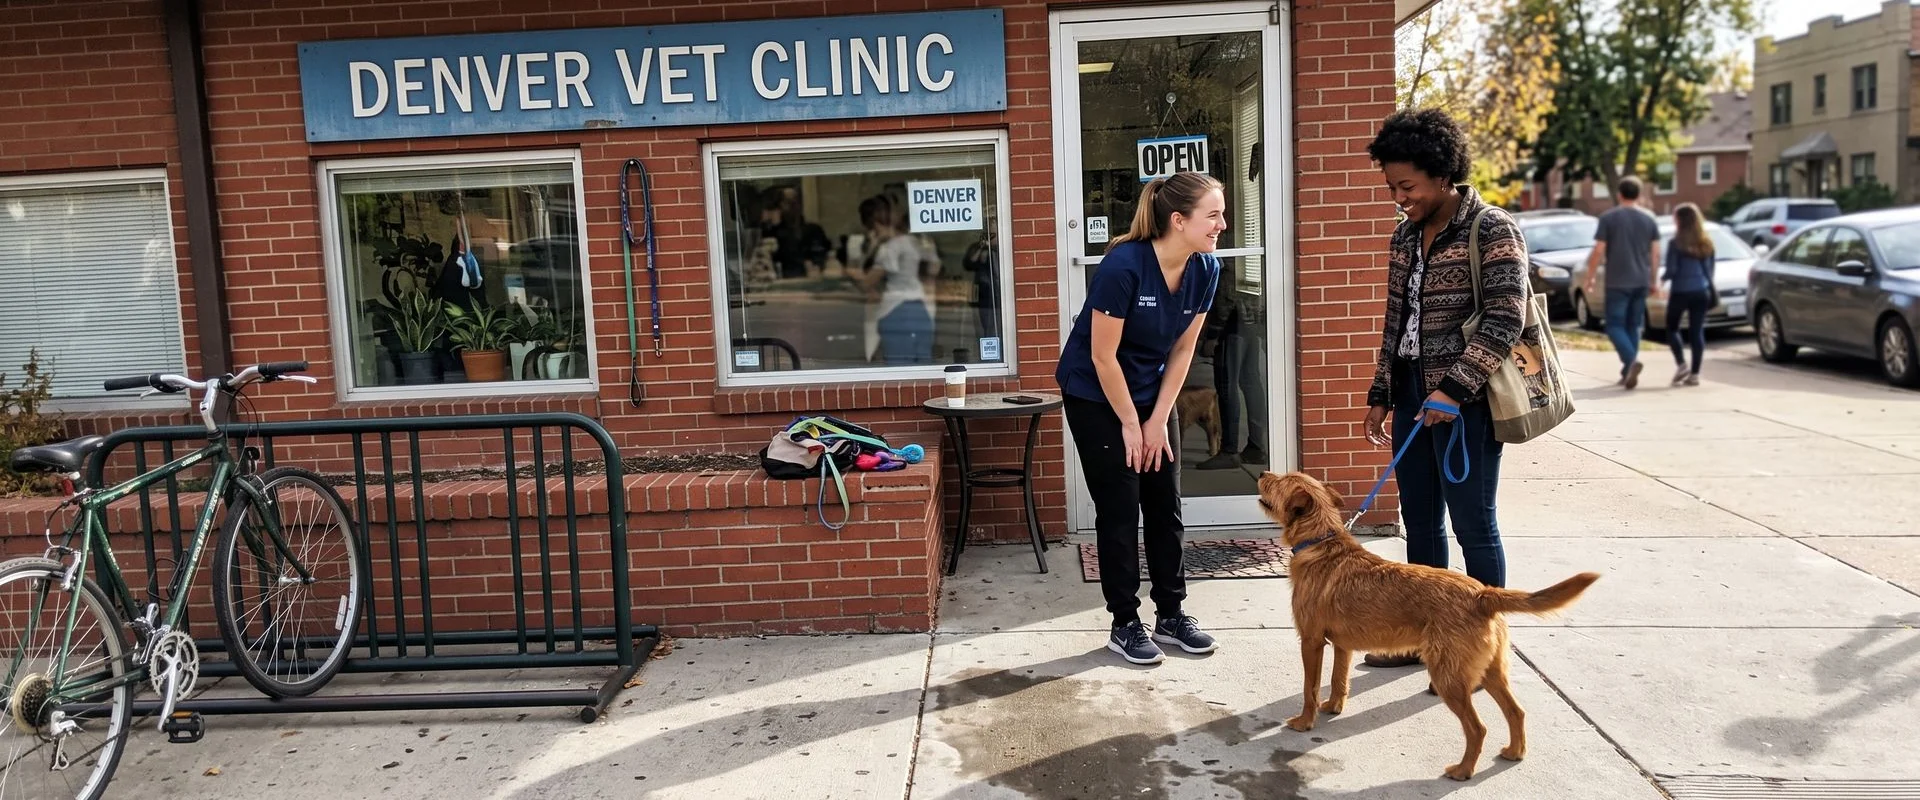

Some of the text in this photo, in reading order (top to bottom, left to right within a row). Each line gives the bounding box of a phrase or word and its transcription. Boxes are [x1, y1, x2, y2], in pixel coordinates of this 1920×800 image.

[349, 33, 954, 117] DENVER VET CLINIC
[1142, 141, 1204, 176] OPEN
[913, 187, 976, 204] DENVER
[920, 207, 972, 224] CLINIC
